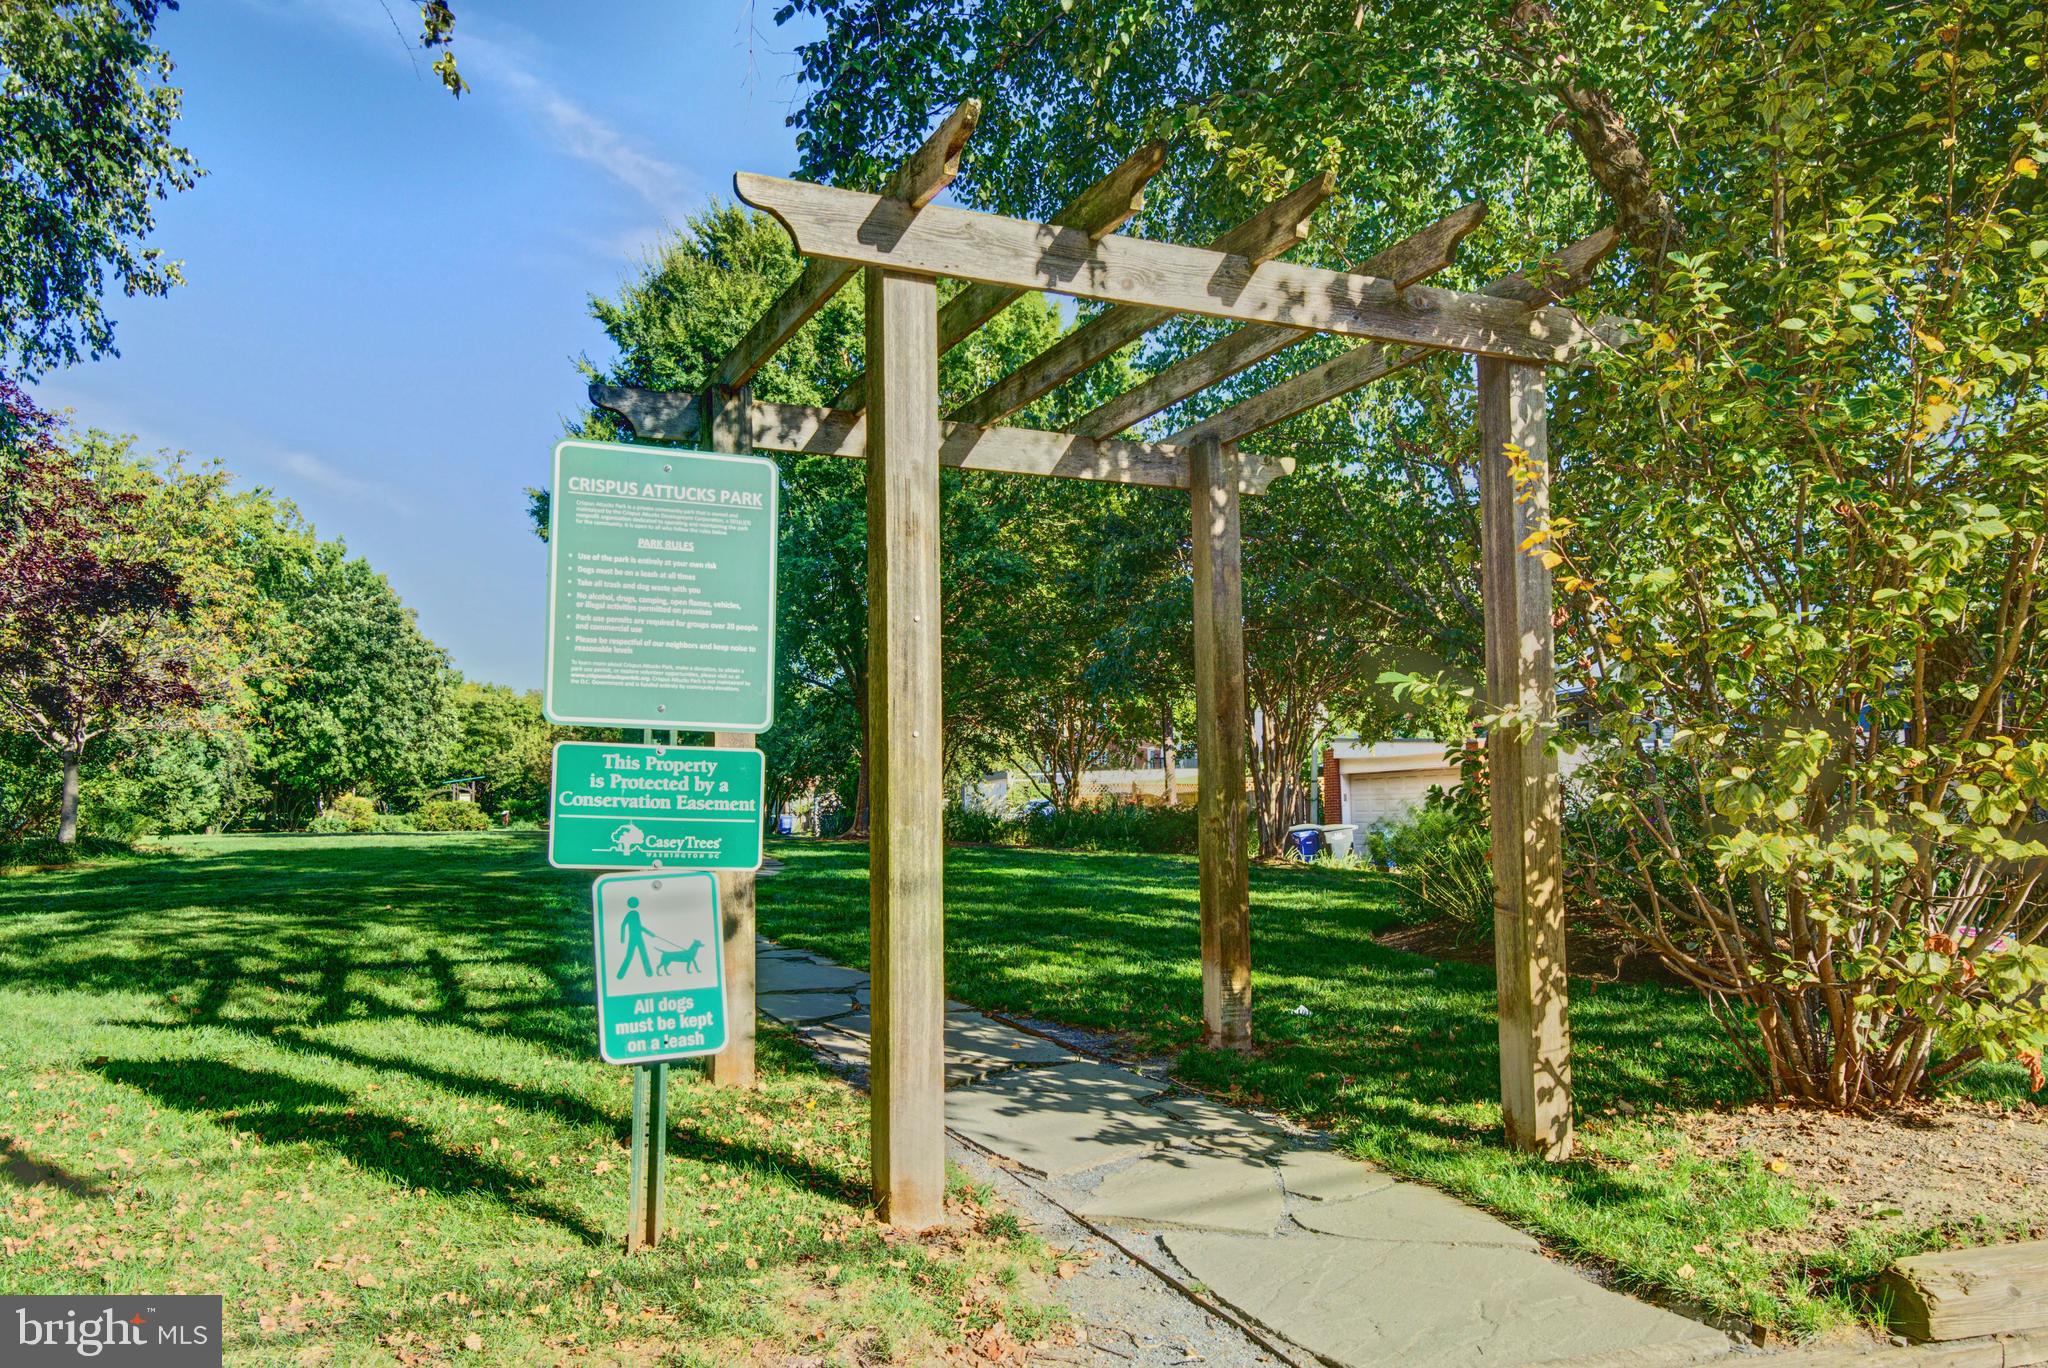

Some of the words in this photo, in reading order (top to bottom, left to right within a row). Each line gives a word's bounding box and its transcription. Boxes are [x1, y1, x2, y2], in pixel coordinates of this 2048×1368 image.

[568, 476, 637, 495] CRISPUS
[643, 483, 715, 502] ATTUCKS
[720, 490, 762, 506] PARK
[638, 538, 663, 548] PARK
[665, 540, 694, 550] RULES
[577, 552, 590, 560] Use
[592, 553, 599, 561] of
[601, 553, 612, 561] the
[614, 554, 629, 564] park
[630, 555, 636, 563] is
[637, 556, 663, 566] entirely
[672, 560, 688, 568] your
[577, 565, 594, 575] Dogs
[640, 569, 657, 577] leash
[677, 572, 695, 580] times
[576, 578, 592, 586] Take
[593, 579, 602, 587] all
[603, 580, 620, 588] trash
[622, 581, 635, 589] and
[636, 582, 649, 591] dog
[651, 583, 670, 591] waste
[671, 584, 687, 592] with
[688, 587, 701, 595] you
[576, 591, 586, 599] No
[587, 592, 615, 602] alcohol,
[615, 594, 637, 603] drugs,
[638, 595, 669, 605] camping,
[688, 599, 712, 608] flames,
[713, 600, 741, 609] vehicles,
[584, 600, 605, 610] illegal
[606, 602, 636, 610] activities
[637, 604, 671, 614] permitted
[682, 606, 712, 616] premises
[575, 613, 591, 621] Park
[606, 615, 632, 625] permits
[646, 618, 674, 627] required
[675, 619, 685, 627] for
[735, 623, 758, 632] people
[575, 621, 588, 629] and
[590, 622, 629, 632] commercial
[574, 644, 612, 653] reasonable
[613, 646, 632, 654] levels
[575, 635, 597, 643] Please
[598, 636, 608, 644] be
[608, 637, 642, 647] respectful
[665, 640, 698, 650] neighbors
[713, 643, 728, 652] keep
[730, 643, 747, 651] noise
[748, 644, 756, 652] to
[602, 753, 641, 770] This
[645, 756, 718, 778] Property
[589, 773, 605, 789] is
[609, 773, 689, 791] Protected
[694, 777, 715, 796] by
[718, 781, 729, 793] a
[558, 790, 671, 810] Conservation
[676, 795, 756, 812] Easement
[645, 835, 685, 852] Casey
[634, 998, 654, 1015] All
[658, 996, 695, 1014] dogs
[615, 1018, 654, 1035] must
[657, 1016, 676, 1031] be
[680, 1011, 714, 1031] kept
[627, 1040, 647, 1053] on
[650, 1039, 661, 1051] a
[664, 1031, 705, 1049] leash
